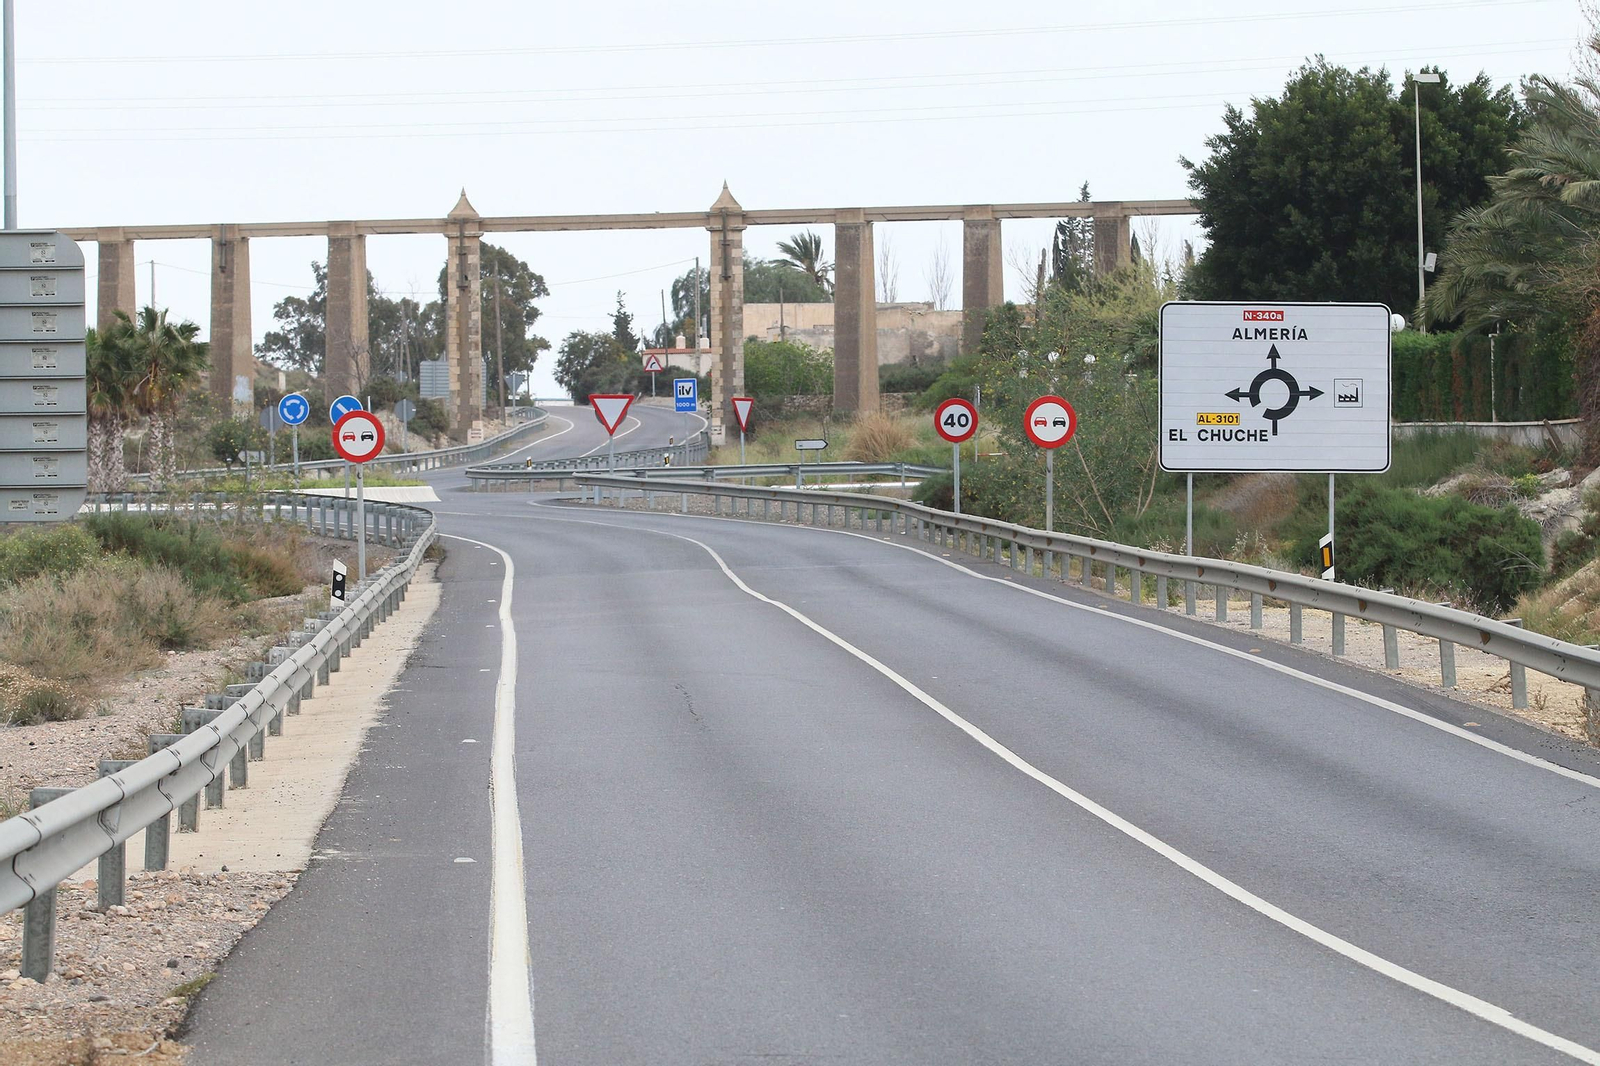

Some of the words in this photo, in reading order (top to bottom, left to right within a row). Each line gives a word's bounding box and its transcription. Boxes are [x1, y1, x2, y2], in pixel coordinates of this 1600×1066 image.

[1244, 312, 1282, 320] N-340a
[1232, 325, 1308, 341] ALMERÍA
[944, 413, 969, 428] 40
[1198, 415, 1239, 423] AL-3101
[1169, 429, 1187, 441] EL
[1197, 429, 1269, 442] CHUCHE
